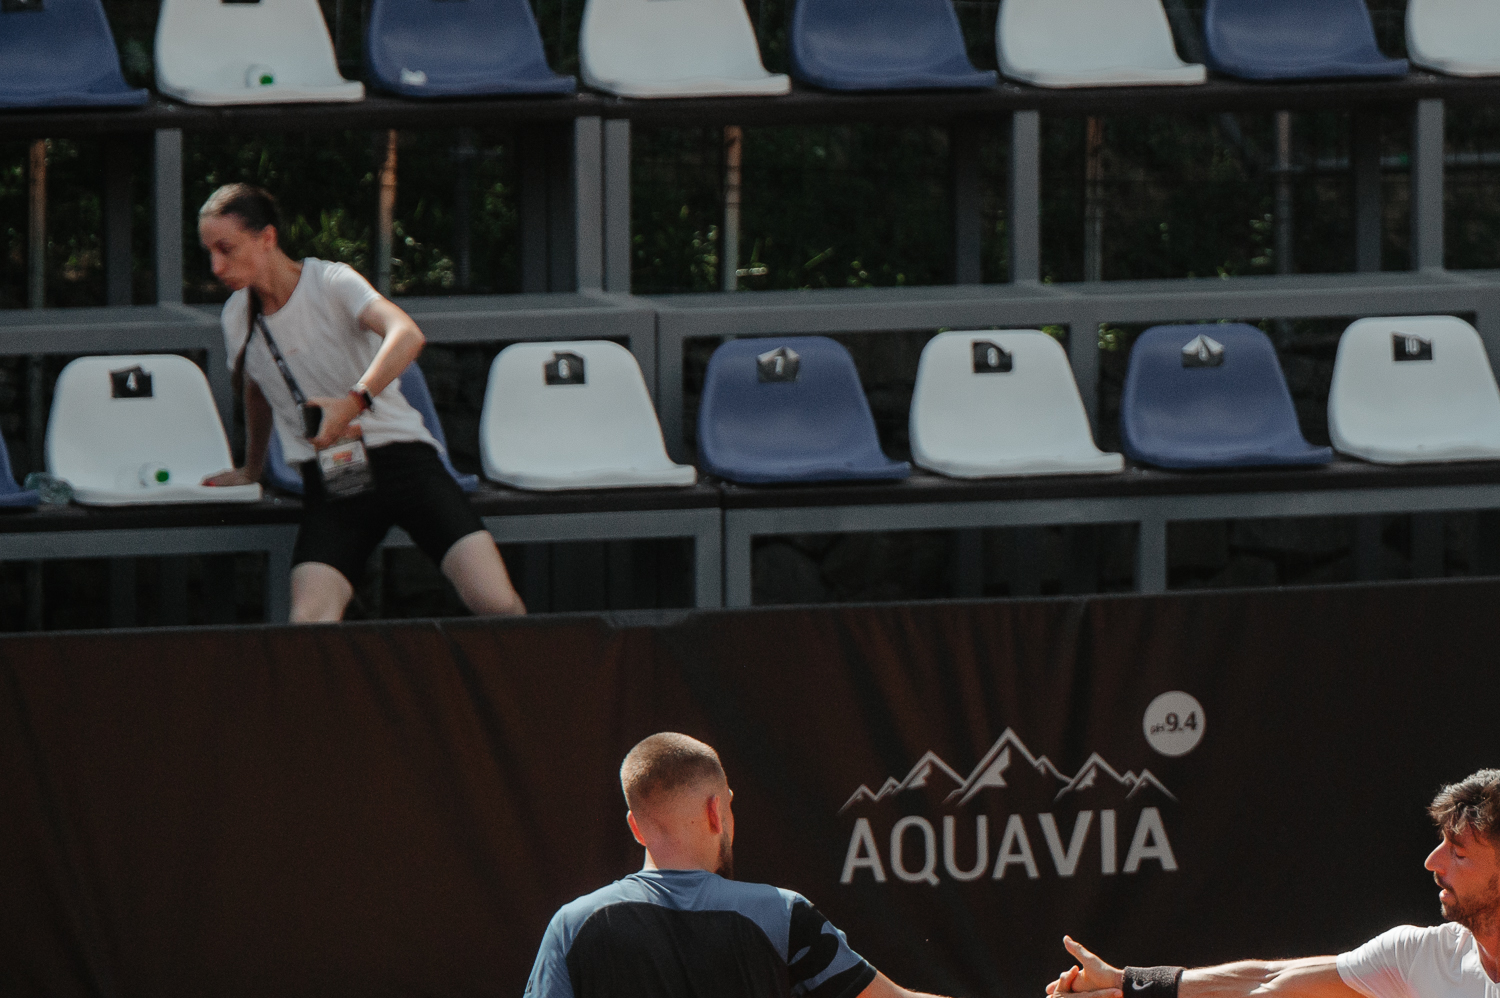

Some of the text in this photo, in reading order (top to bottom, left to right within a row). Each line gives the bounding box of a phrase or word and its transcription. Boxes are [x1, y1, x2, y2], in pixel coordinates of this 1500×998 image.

[126, 372, 138, 391] 4
[1165, 710, 1198, 733] 9.4
[839, 807, 1179, 887] AQUAVIA
